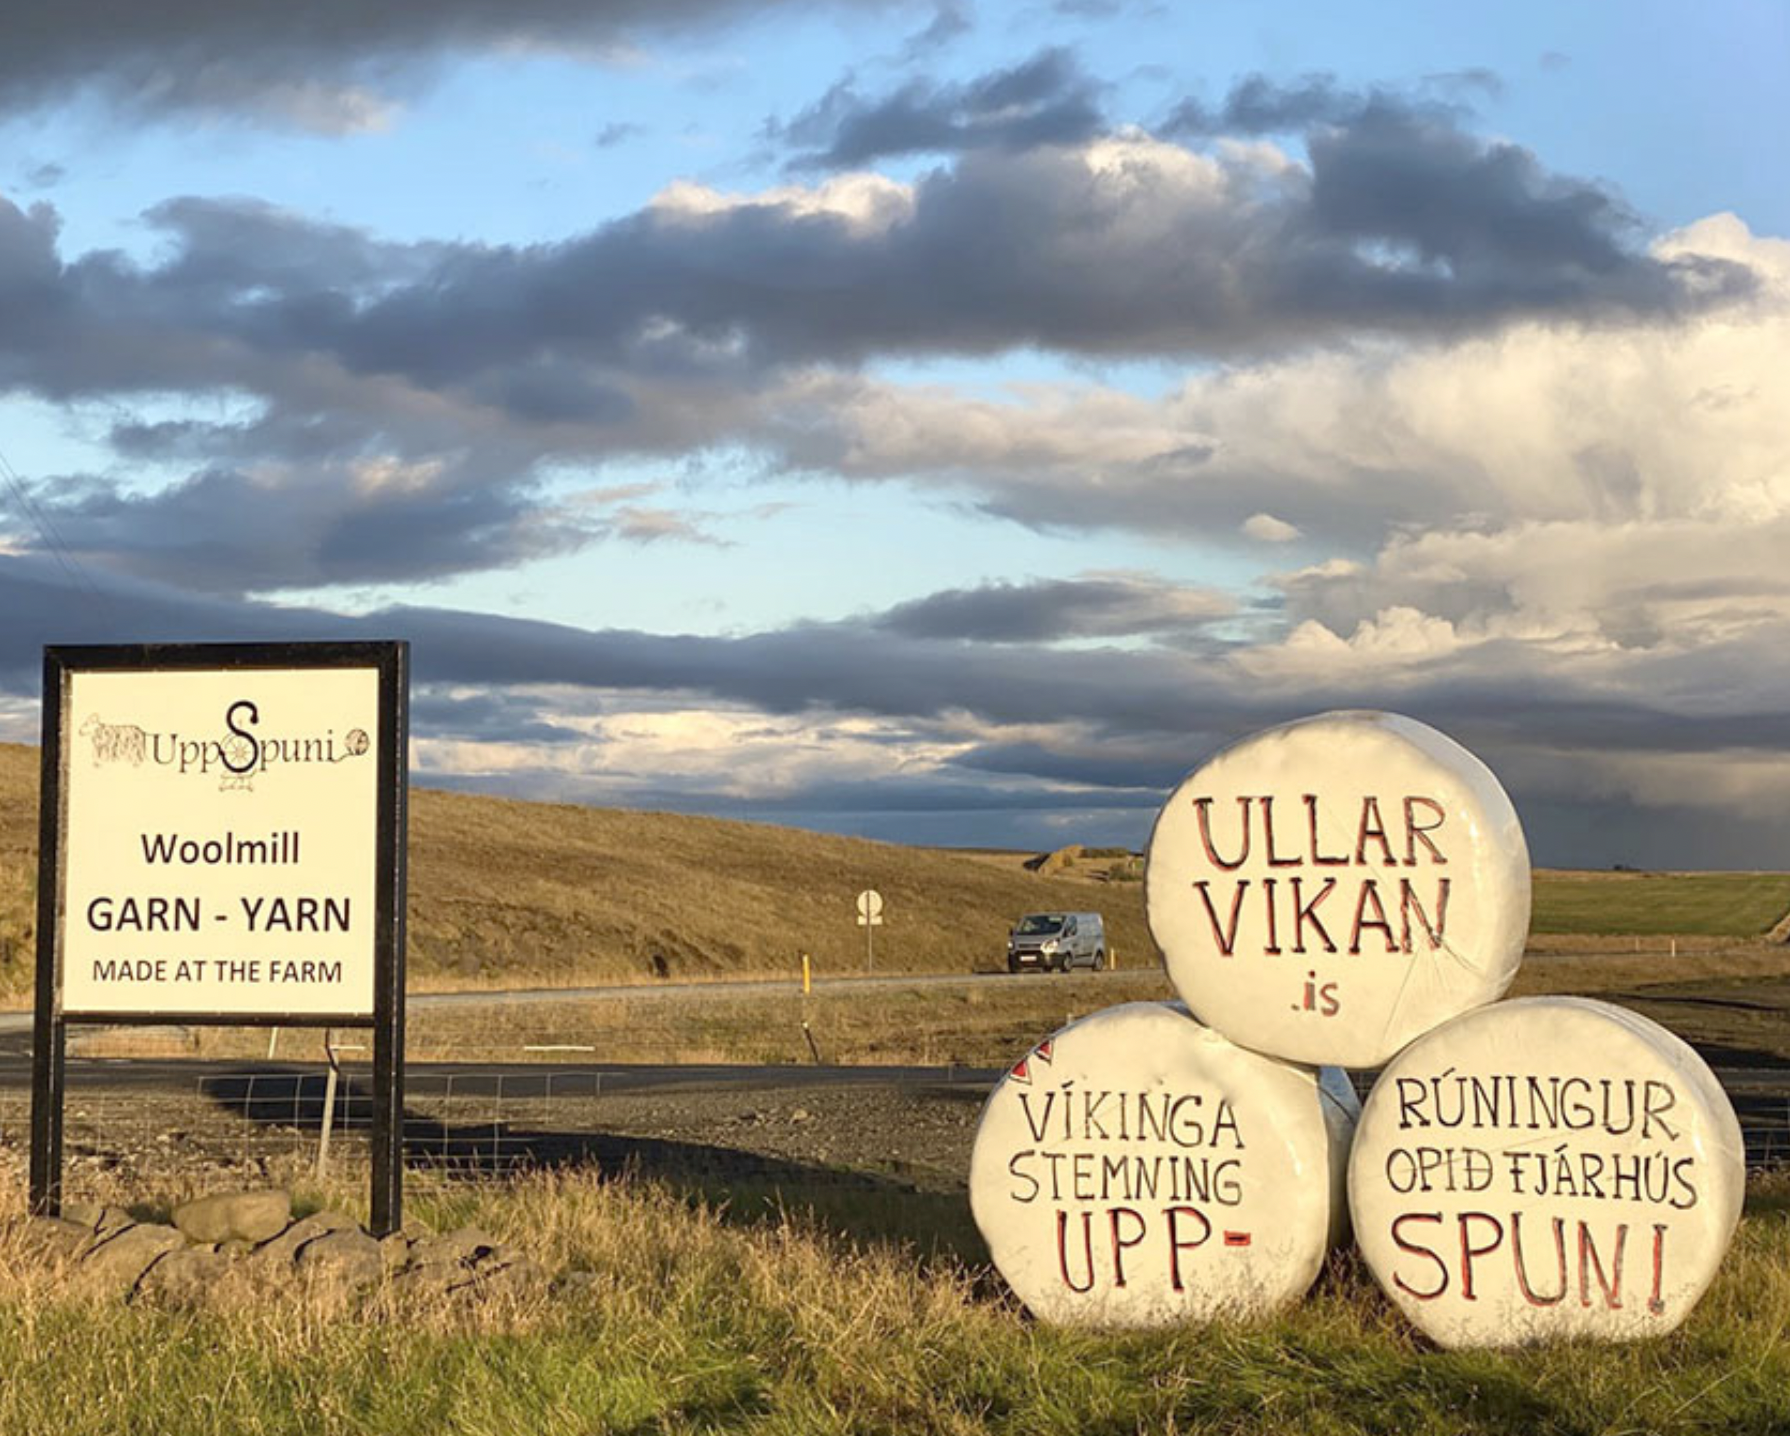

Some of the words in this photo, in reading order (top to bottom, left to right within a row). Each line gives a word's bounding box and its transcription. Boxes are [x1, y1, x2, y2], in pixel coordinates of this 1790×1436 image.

[153, 700, 336, 774] UppSpuni
[141, 831, 299, 864] Woolmill
[1192, 794, 1449, 871] ULLAR
[87, 897, 201, 932] GARN
[241, 897, 351, 932] YARN
[1192, 876, 1451, 957] VIKAN
[92, 960, 167, 982] MADE
[175, 960, 207, 982] AT
[214, 961, 260, 982] THE
[269, 961, 342, 983] FARM
[1290, 970, 1341, 1017] .is
[1018, 1080, 1246, 1150] VÍKINGA
[1396, 1067, 1680, 1142] RÚNINGUR
[1008, 1149, 1243, 1207] STEMNING
[1385, 1146, 1494, 1194] OPIÐ
